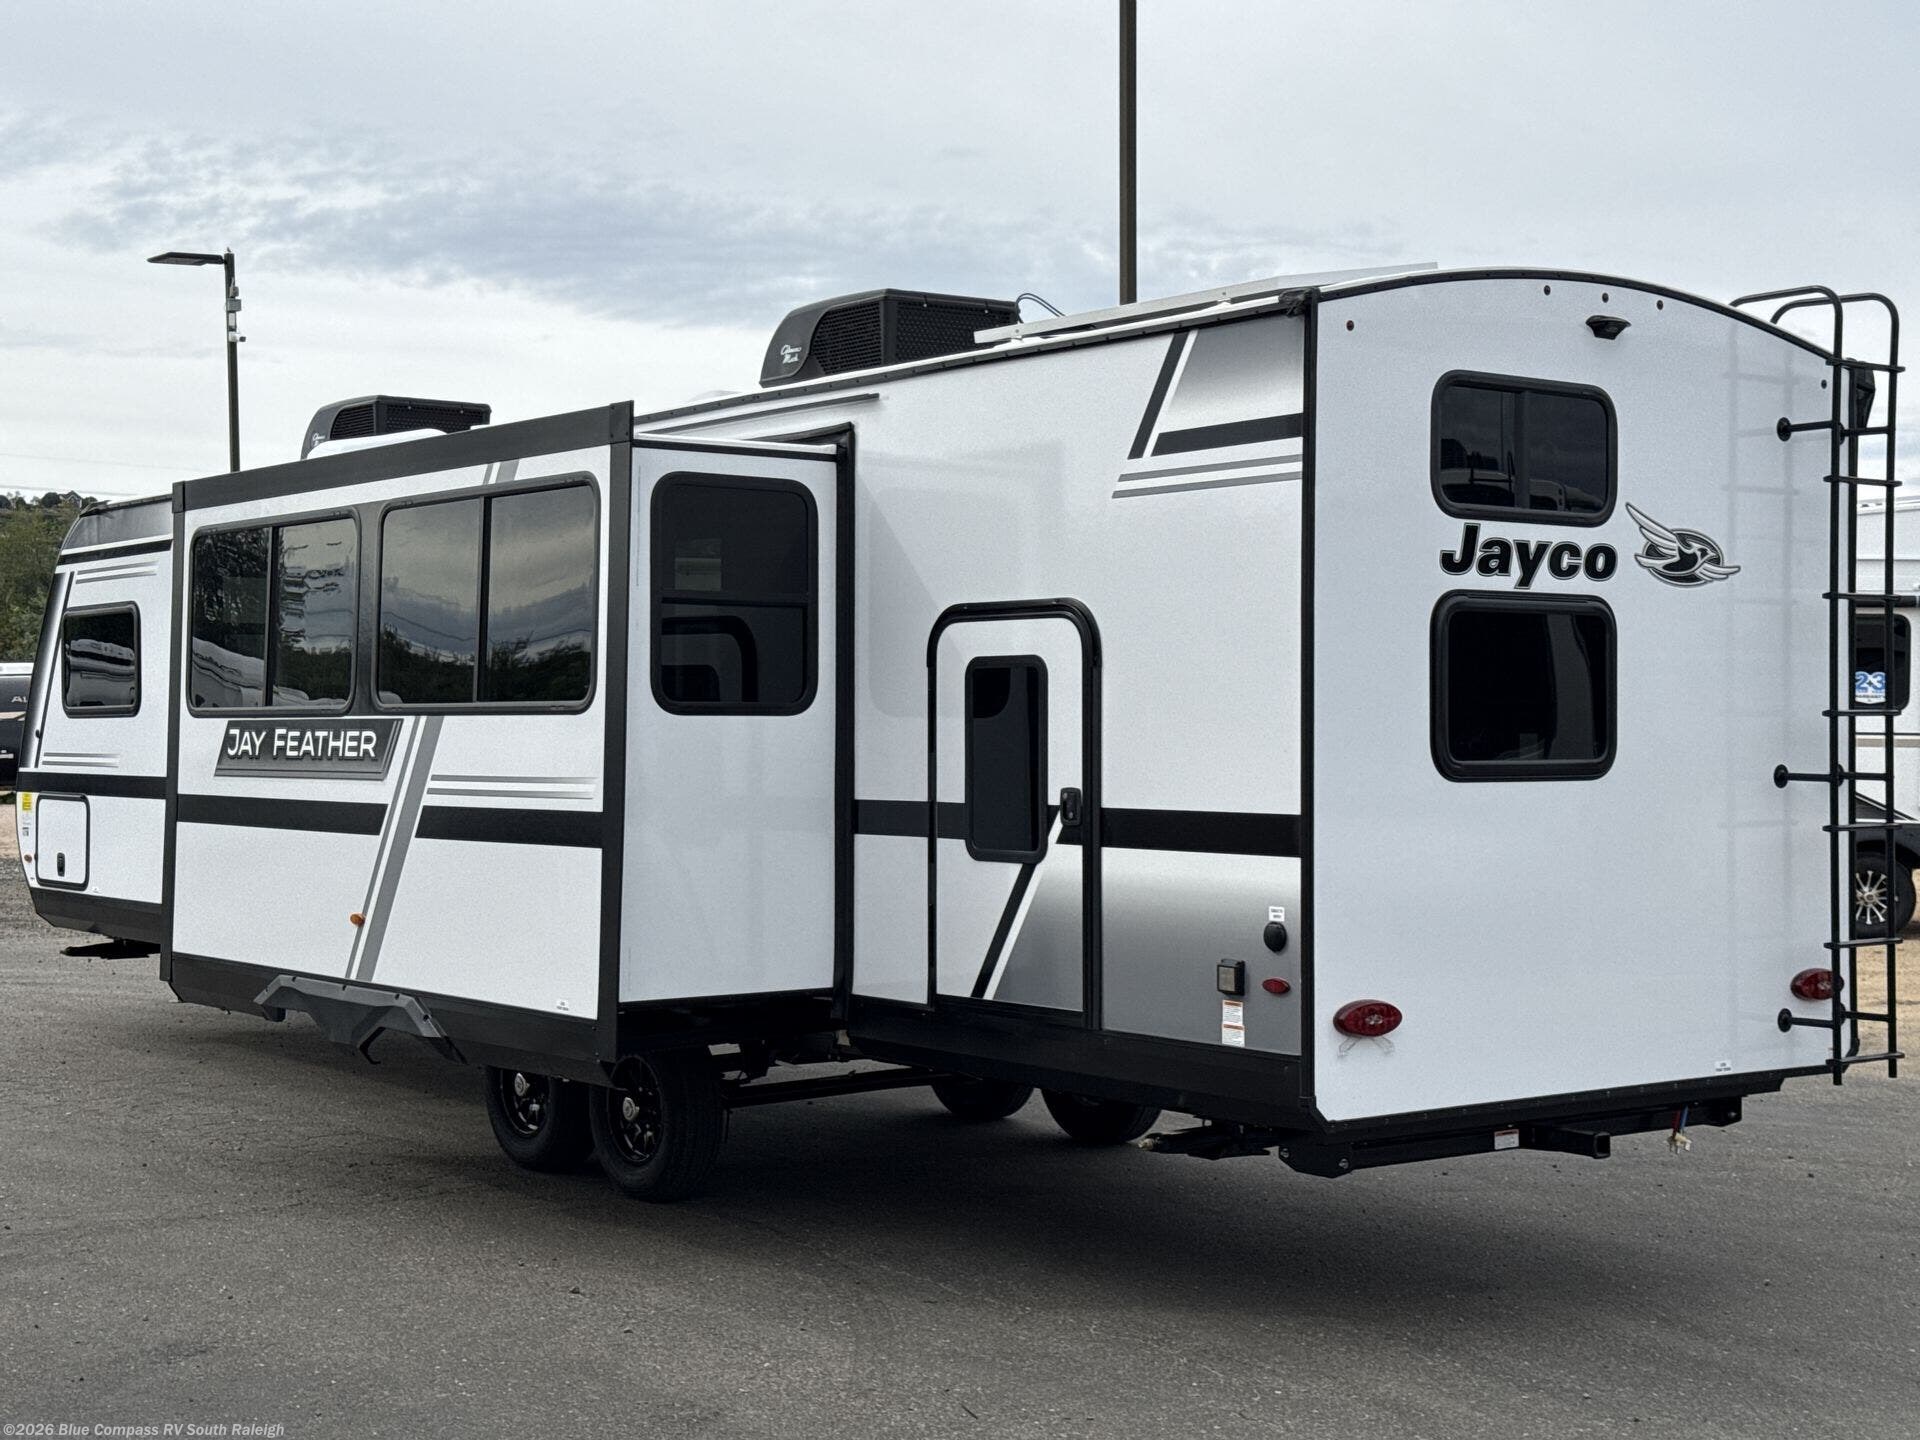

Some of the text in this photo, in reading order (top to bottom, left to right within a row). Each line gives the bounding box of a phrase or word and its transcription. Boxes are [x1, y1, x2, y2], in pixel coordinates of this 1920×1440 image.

[1439, 522, 1619, 589] Jayco
[227, 728, 378, 758] JAY FEATHER
